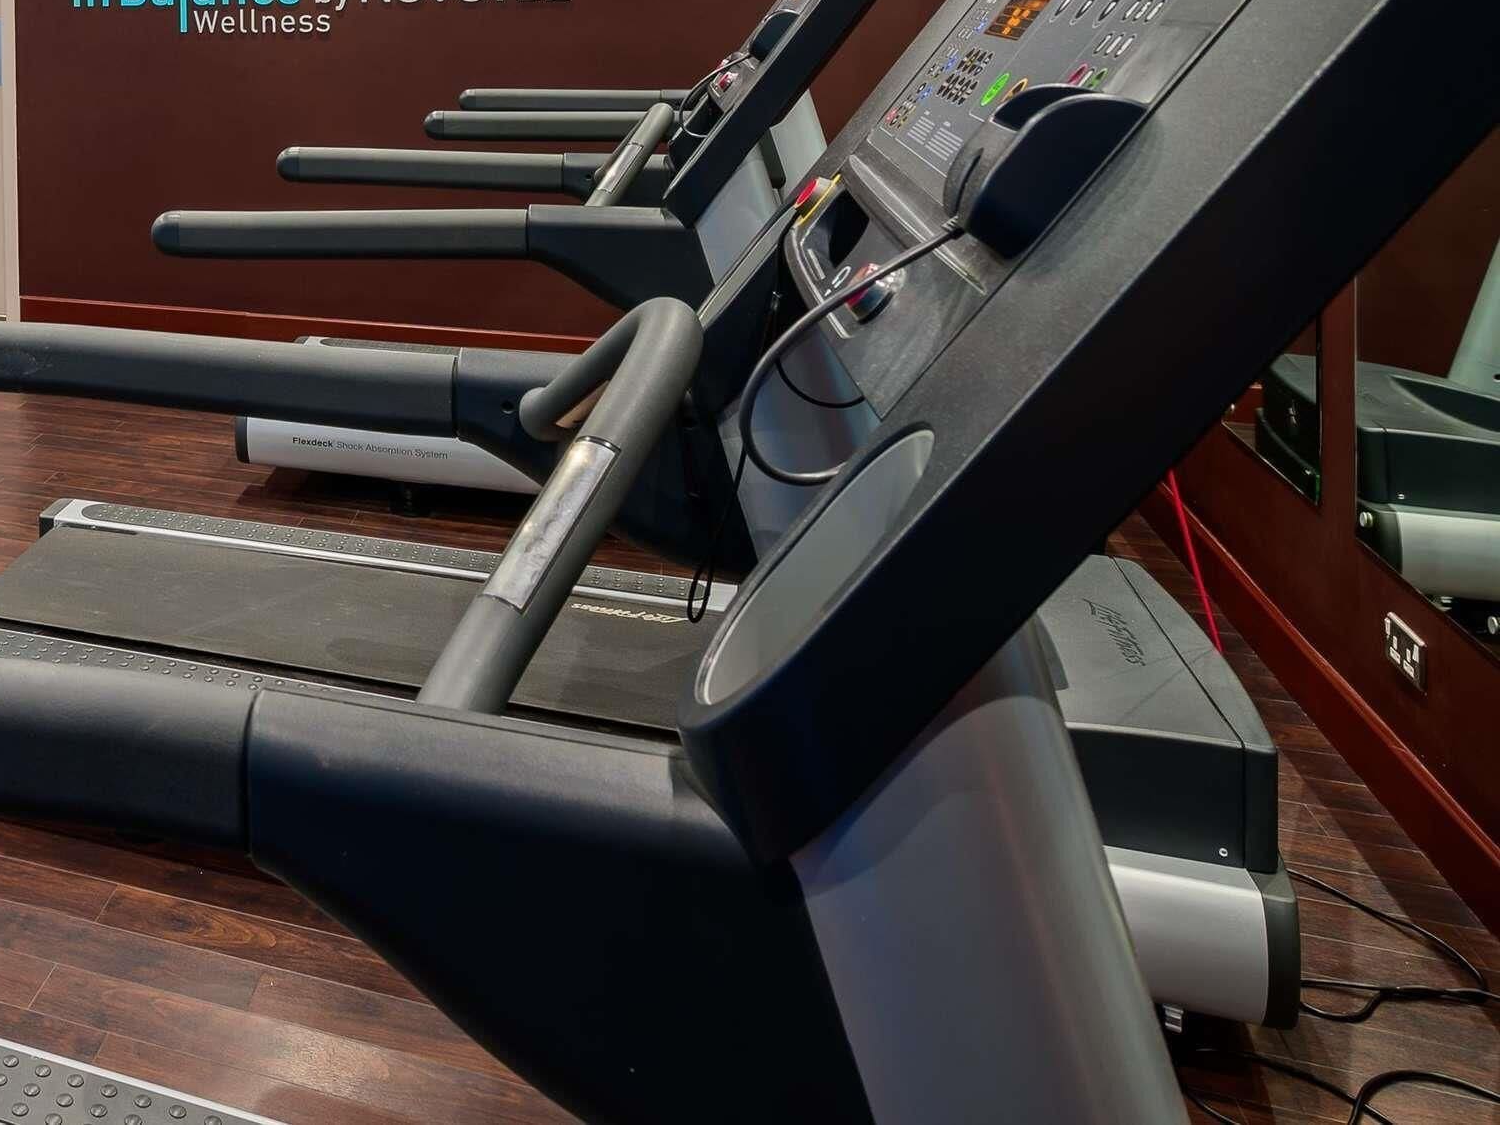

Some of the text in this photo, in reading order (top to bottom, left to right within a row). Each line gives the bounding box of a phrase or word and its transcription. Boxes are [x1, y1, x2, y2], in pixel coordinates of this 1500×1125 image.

[193, 8, 331, 34] Wellness
[292, 436, 449, 460] Flexdeck Shock Absorption System
